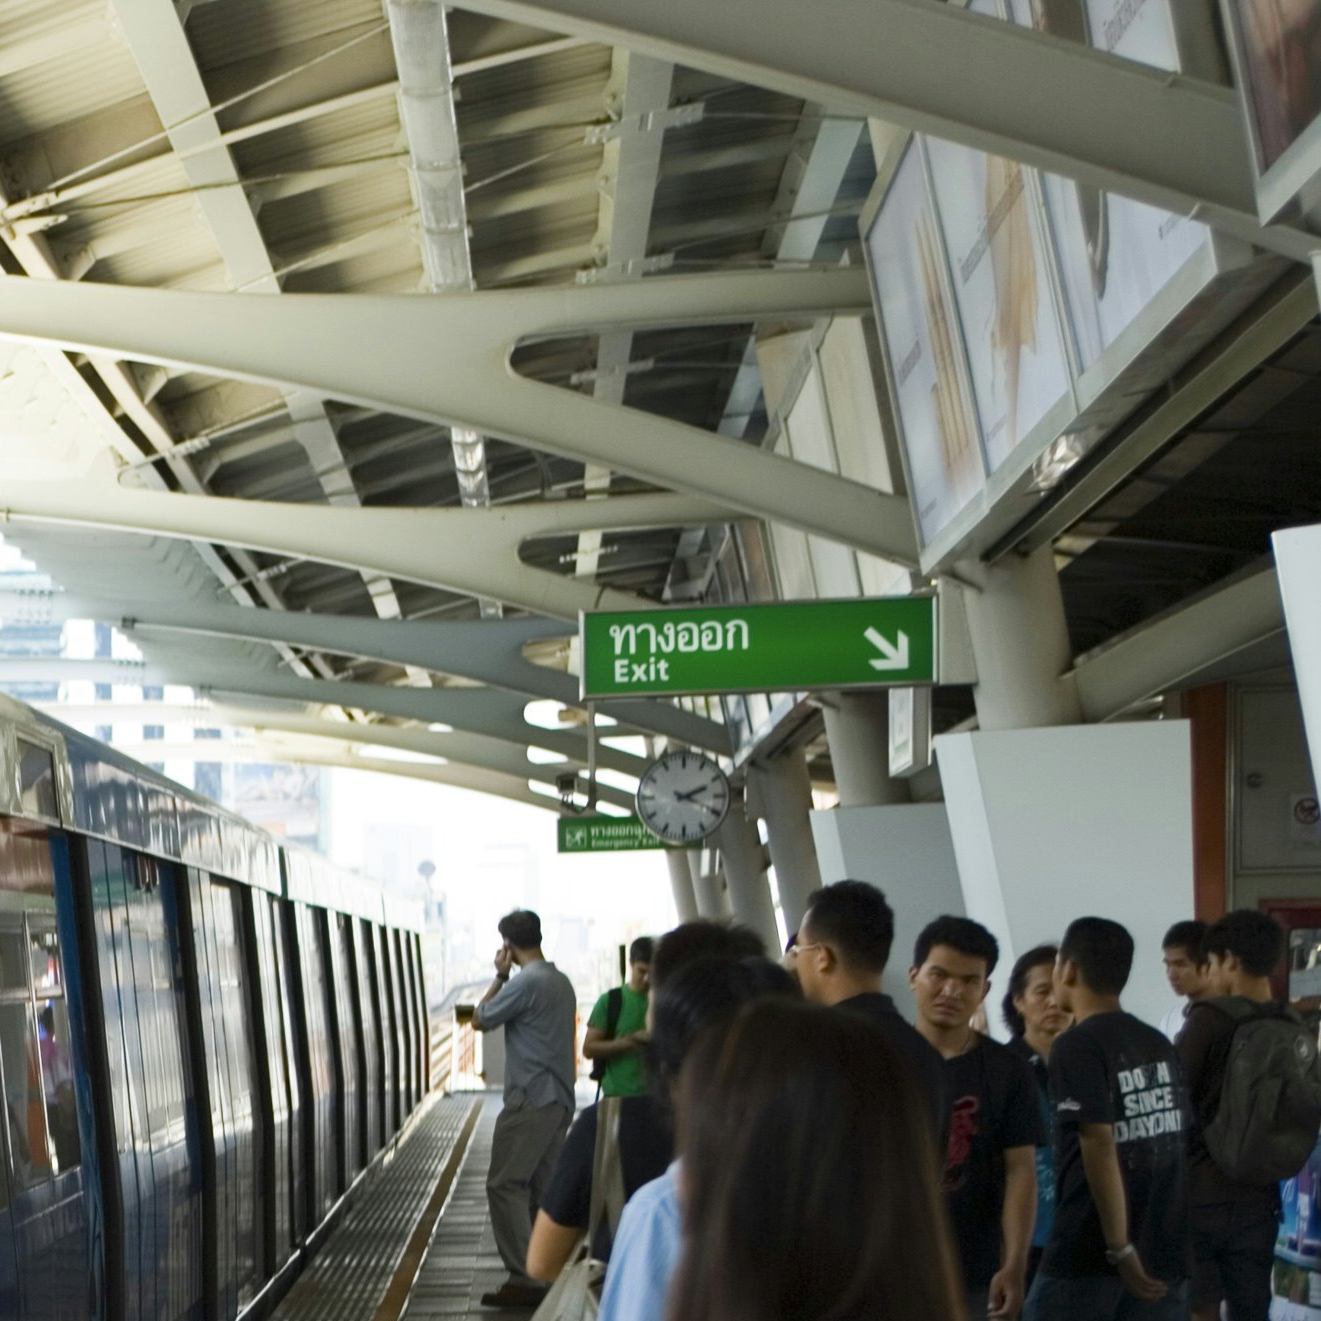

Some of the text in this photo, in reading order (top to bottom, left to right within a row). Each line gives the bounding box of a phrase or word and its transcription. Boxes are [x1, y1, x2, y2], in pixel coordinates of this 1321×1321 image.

[609, 618, 749, 655] ทางออก
[614, 656, 670, 683] Exit
[1123, 1086, 1173, 1118] SINCE
